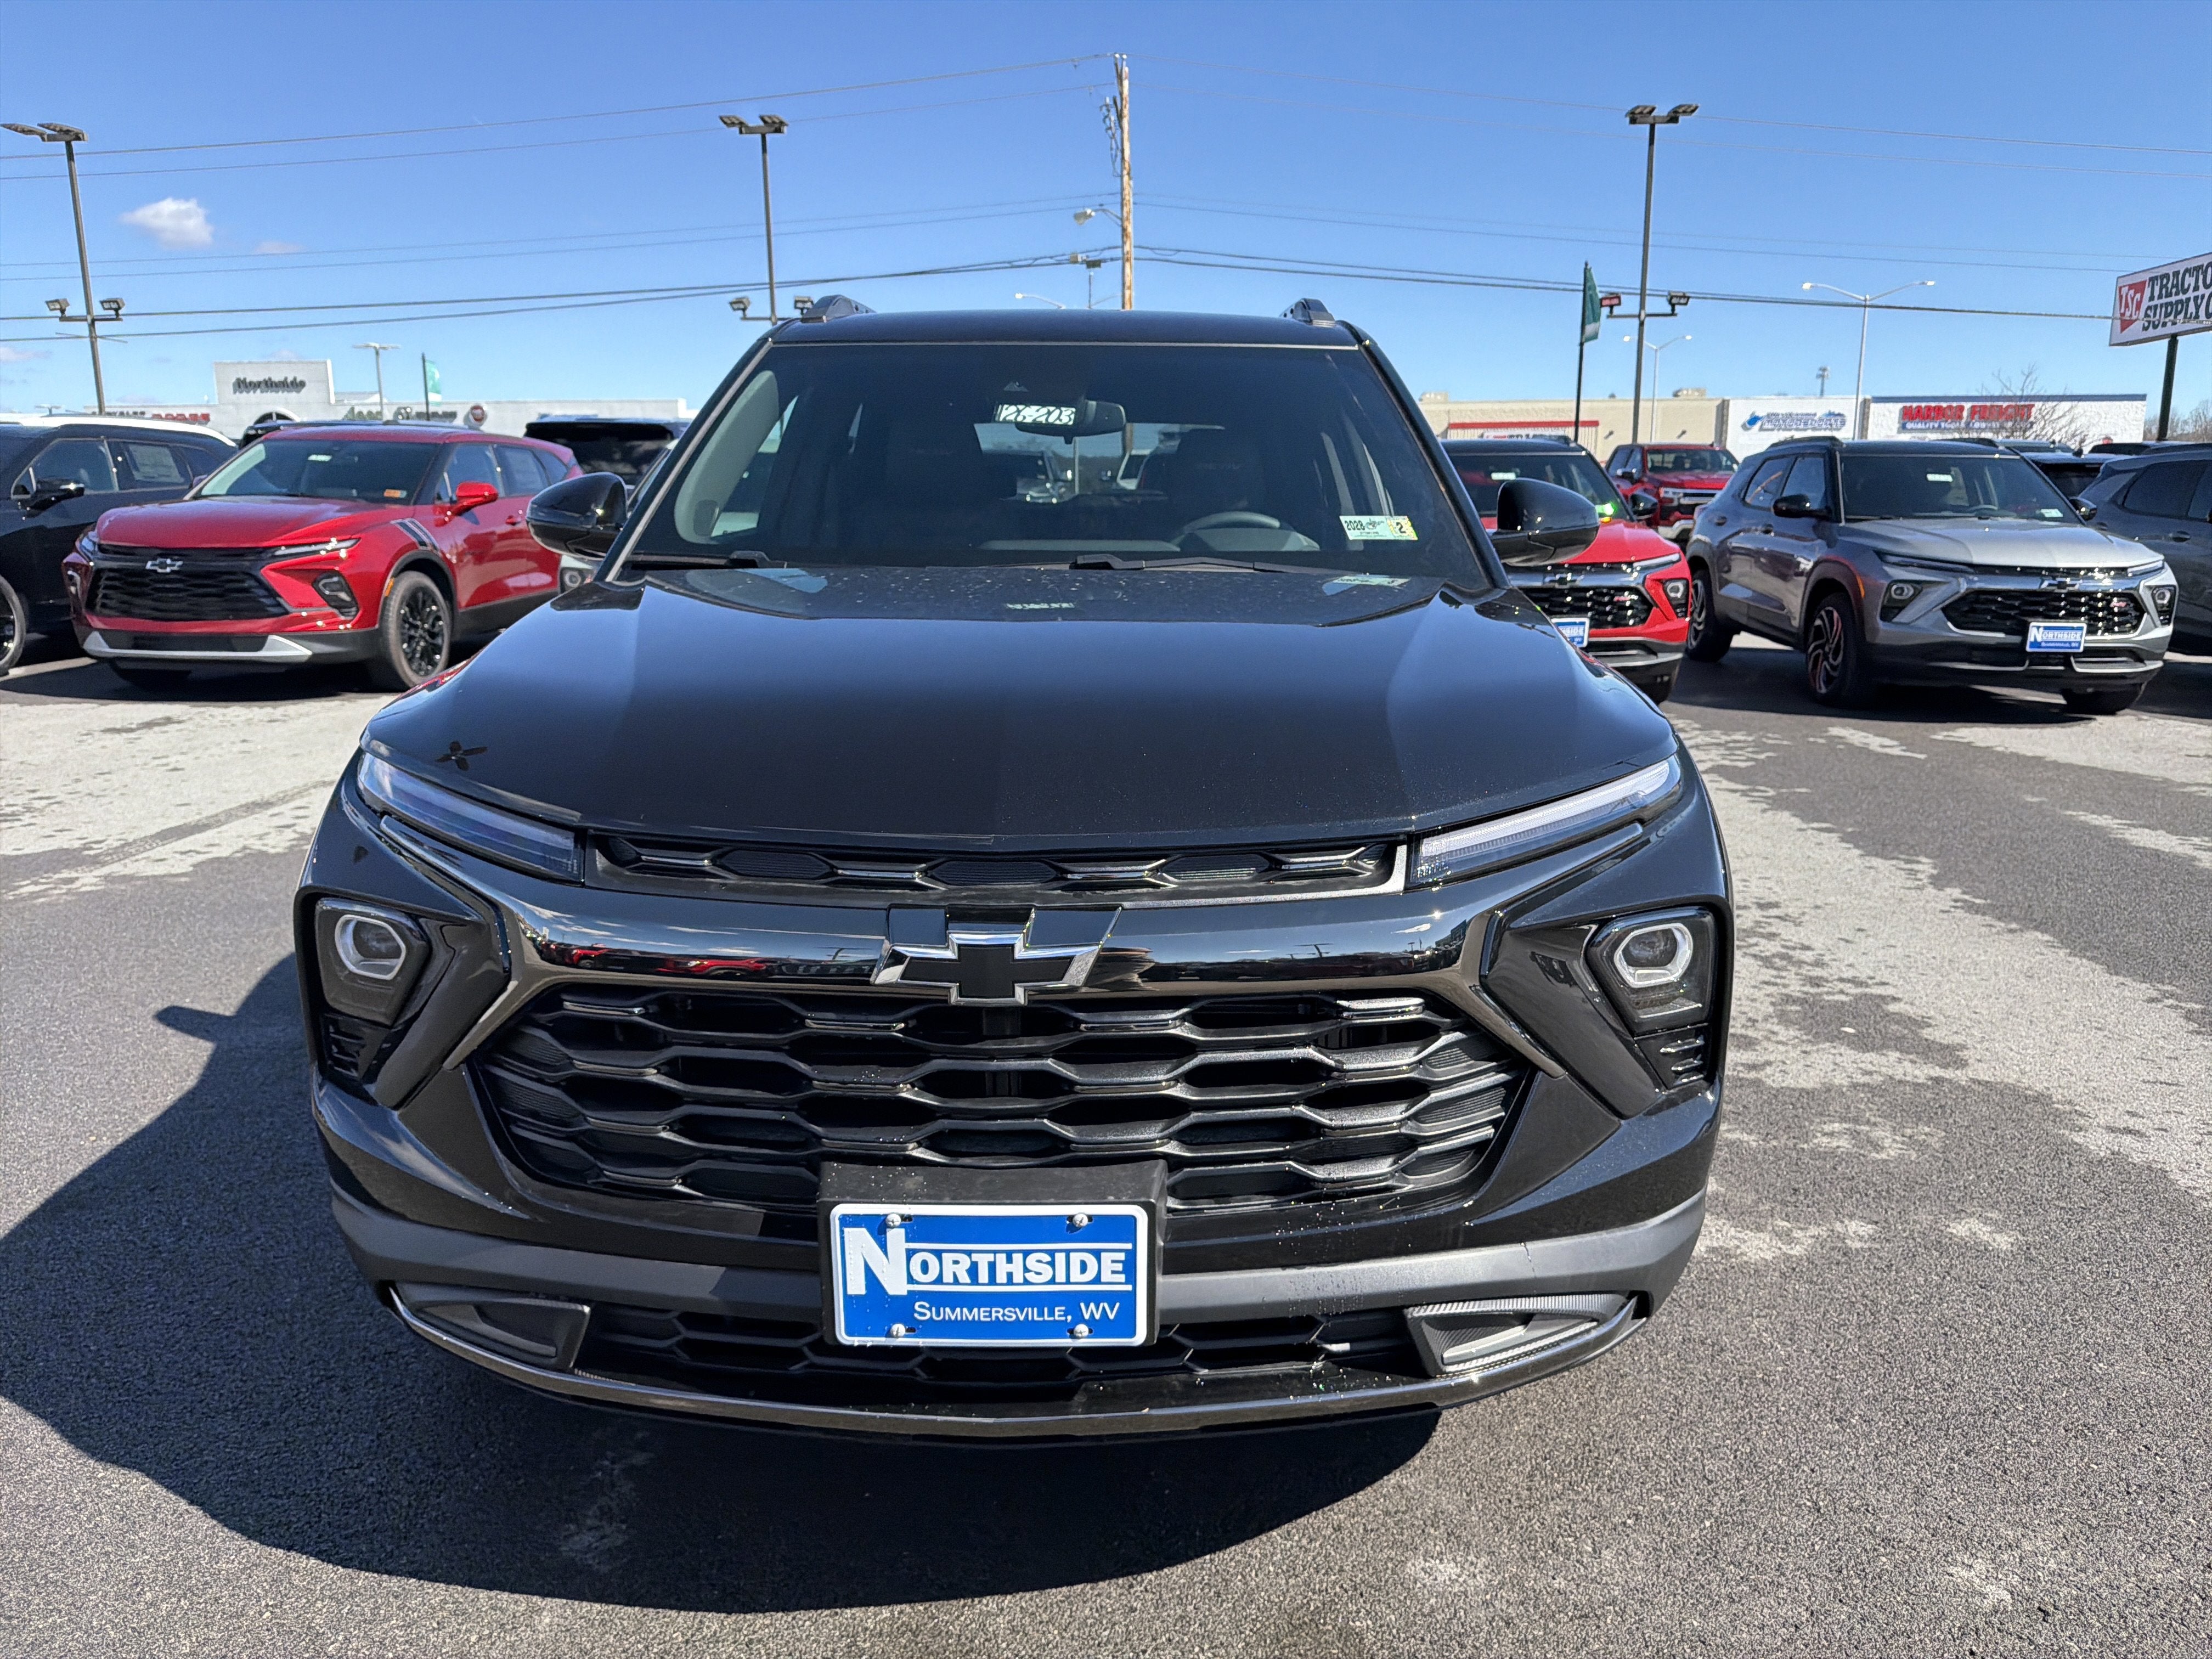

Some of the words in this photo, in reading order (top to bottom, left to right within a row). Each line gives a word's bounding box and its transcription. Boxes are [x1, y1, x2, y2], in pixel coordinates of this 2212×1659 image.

[2120, 285, 2141, 320] TSC
[2142, 294, 2205, 332] SUPPLY
[1901, 405, 1965, 421] HARBOR
[1396, 522, 1407, 534] 2
[2030, 627, 2083, 642] NORTHSIDE
[843, 1227, 1126, 1296] NORTHSIDE
[1080, 1301, 1120, 1320] WV
